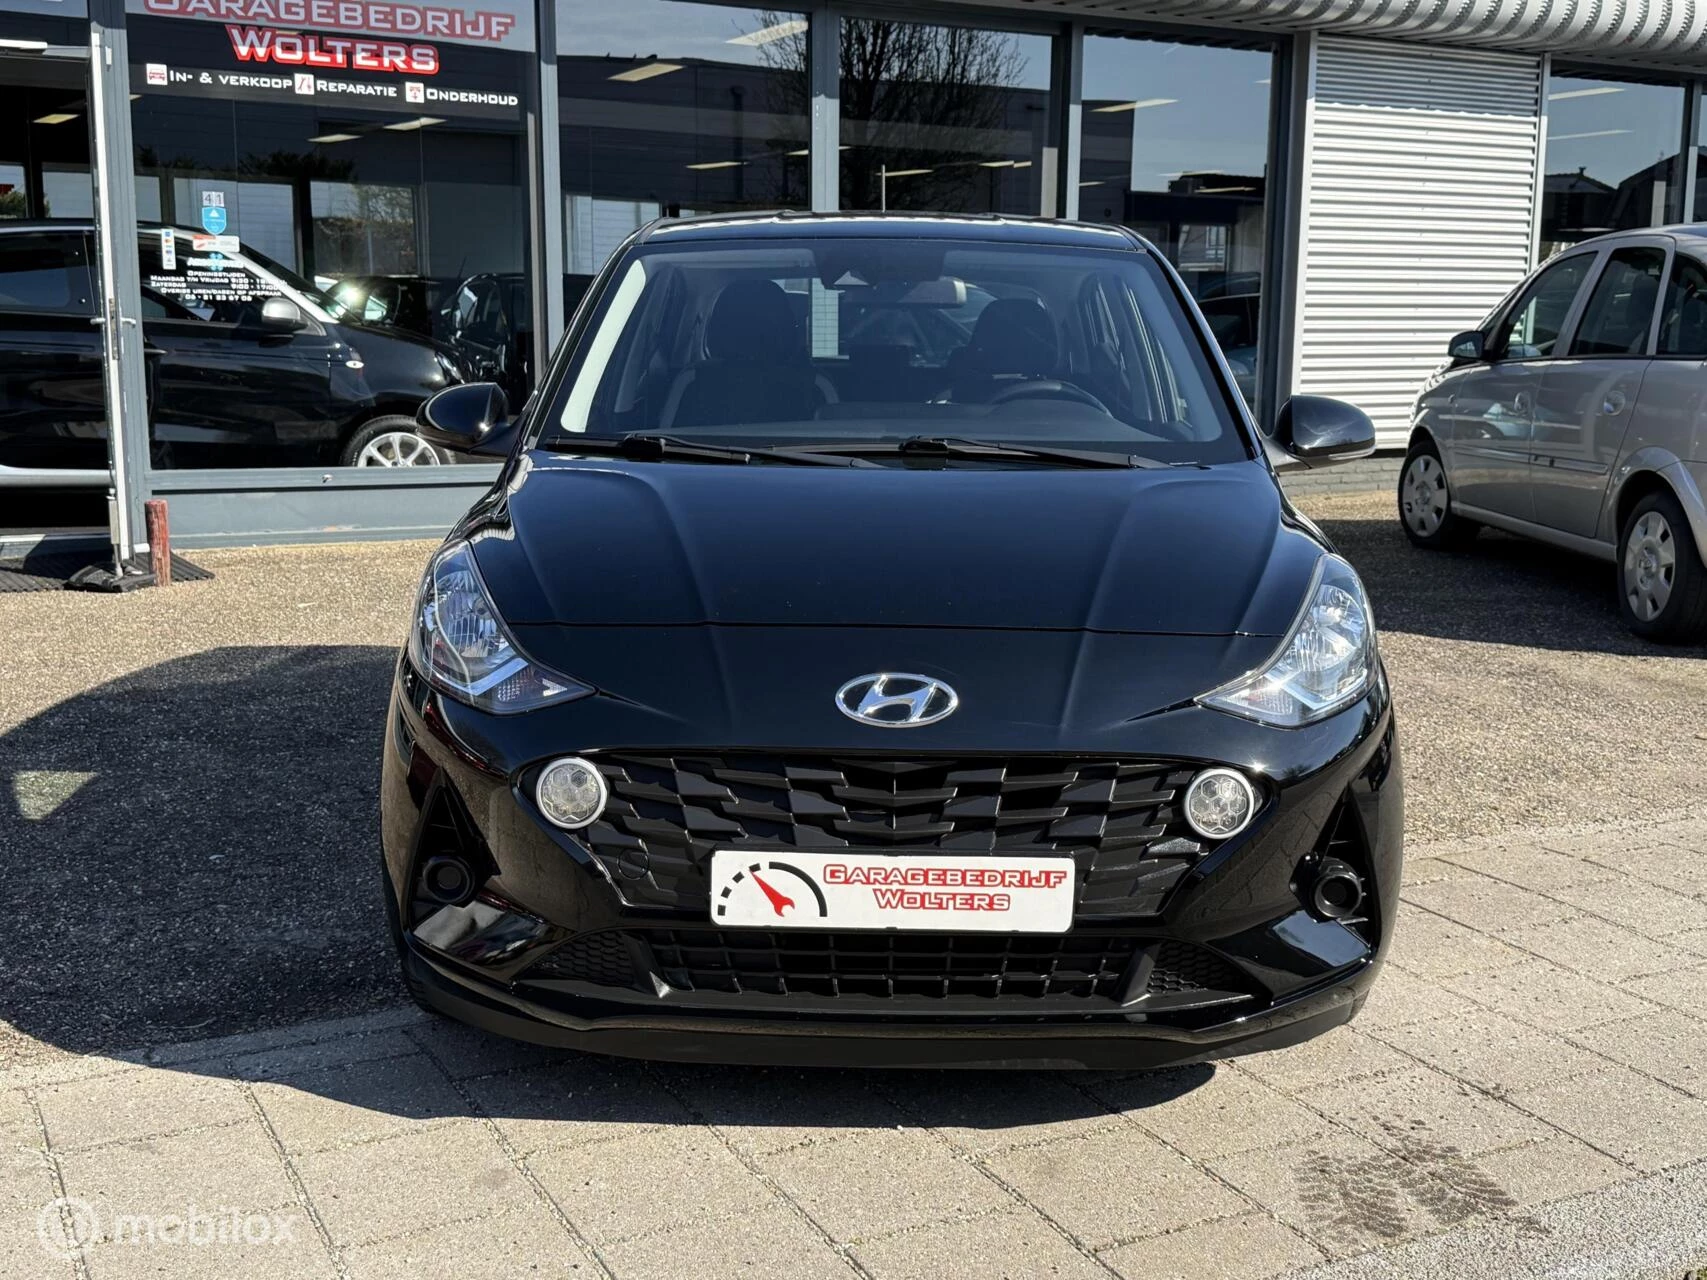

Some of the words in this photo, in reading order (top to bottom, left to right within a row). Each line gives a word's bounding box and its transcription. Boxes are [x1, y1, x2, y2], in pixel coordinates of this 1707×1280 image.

[226, 24, 439, 75] WOLTERS
[200, 72, 212, 84] &
[218, 74, 293, 89] VERKOOP
[316, 79, 397, 97] REPARATIE
[426, 88, 518, 106] ONDERHOUD
[823, 864, 1067, 888] GARAGEBEDRIJF
[873, 888, 1010, 911] WOLTERS
